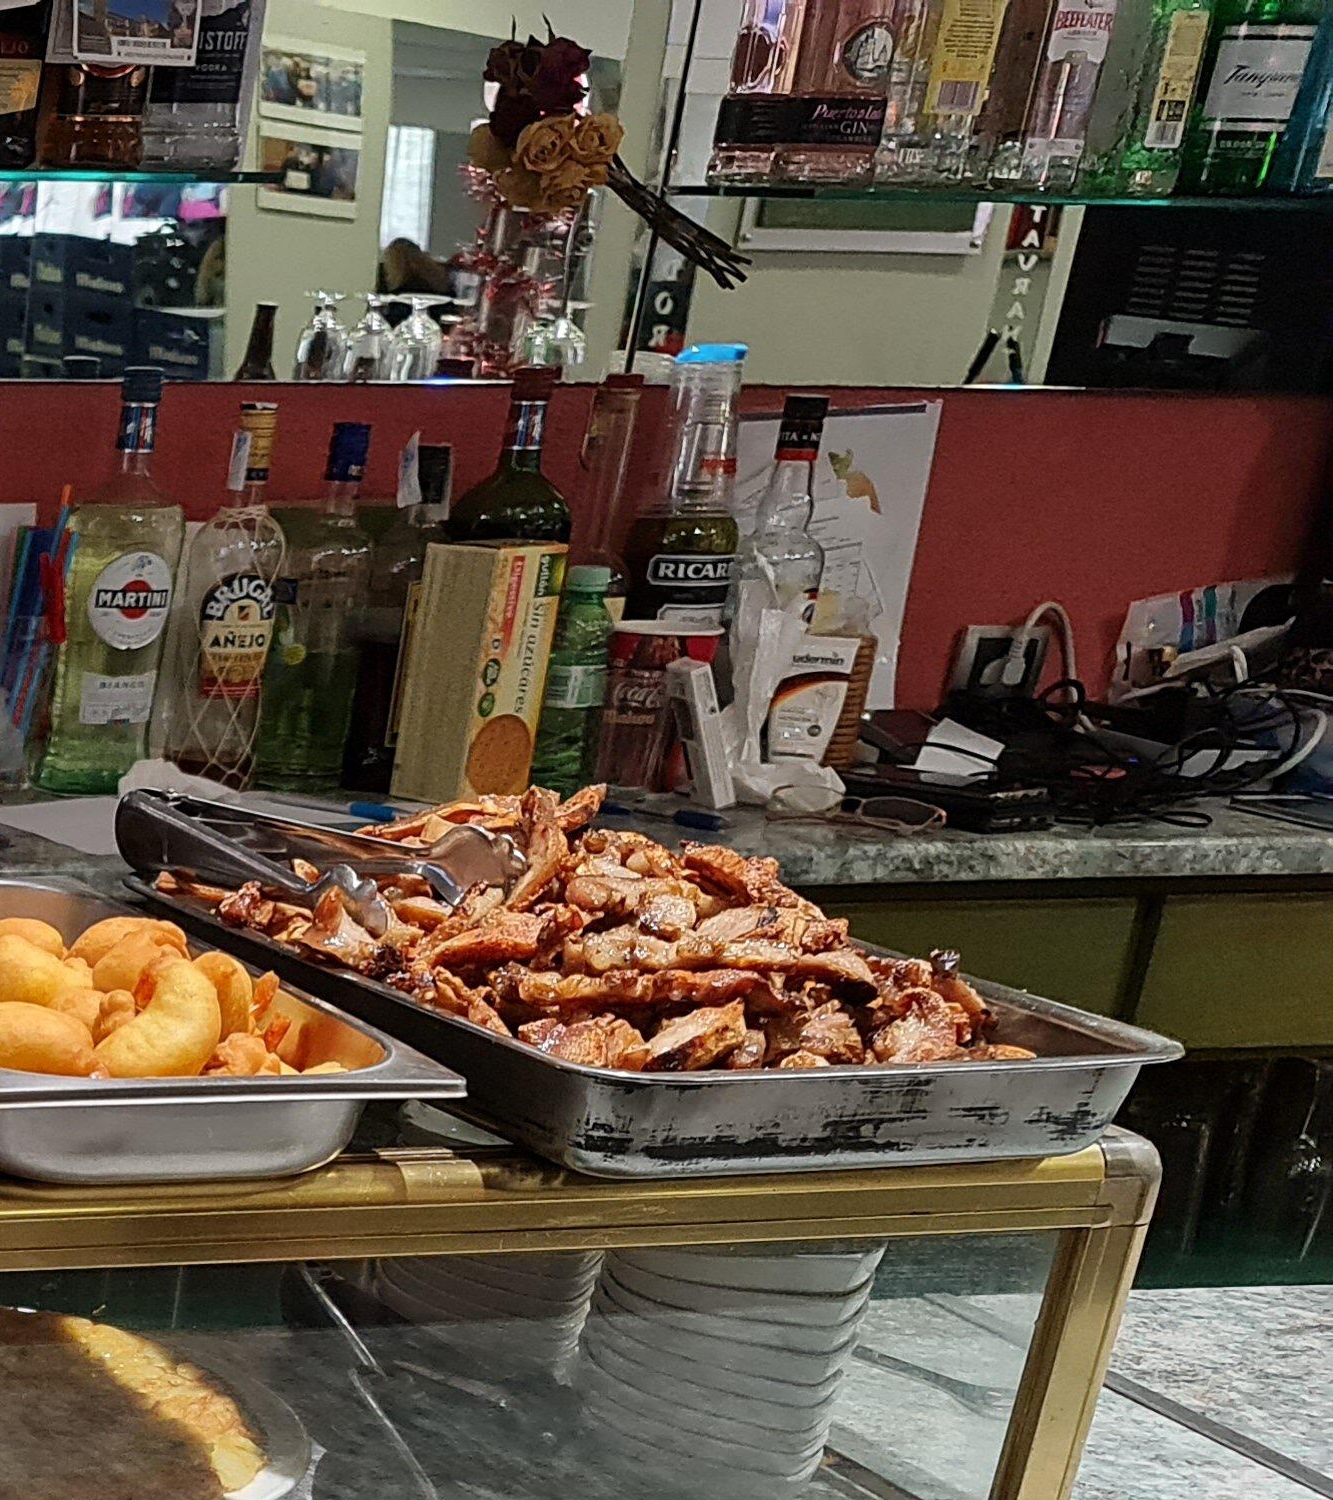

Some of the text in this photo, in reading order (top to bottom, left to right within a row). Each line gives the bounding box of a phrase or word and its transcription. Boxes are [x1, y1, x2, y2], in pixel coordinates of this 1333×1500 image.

[1055, 11, 1113, 31] BEEFEATER
[199, 30, 248, 50] ISTOFF
[840, 121, 869, 134] GIN
[657, 562, 733, 579] RICAR
[97, 590, 168, 608] MARTINI
[205, 577, 275, 619] BRUGAL
[209, 630, 267, 649] AÑEJO
